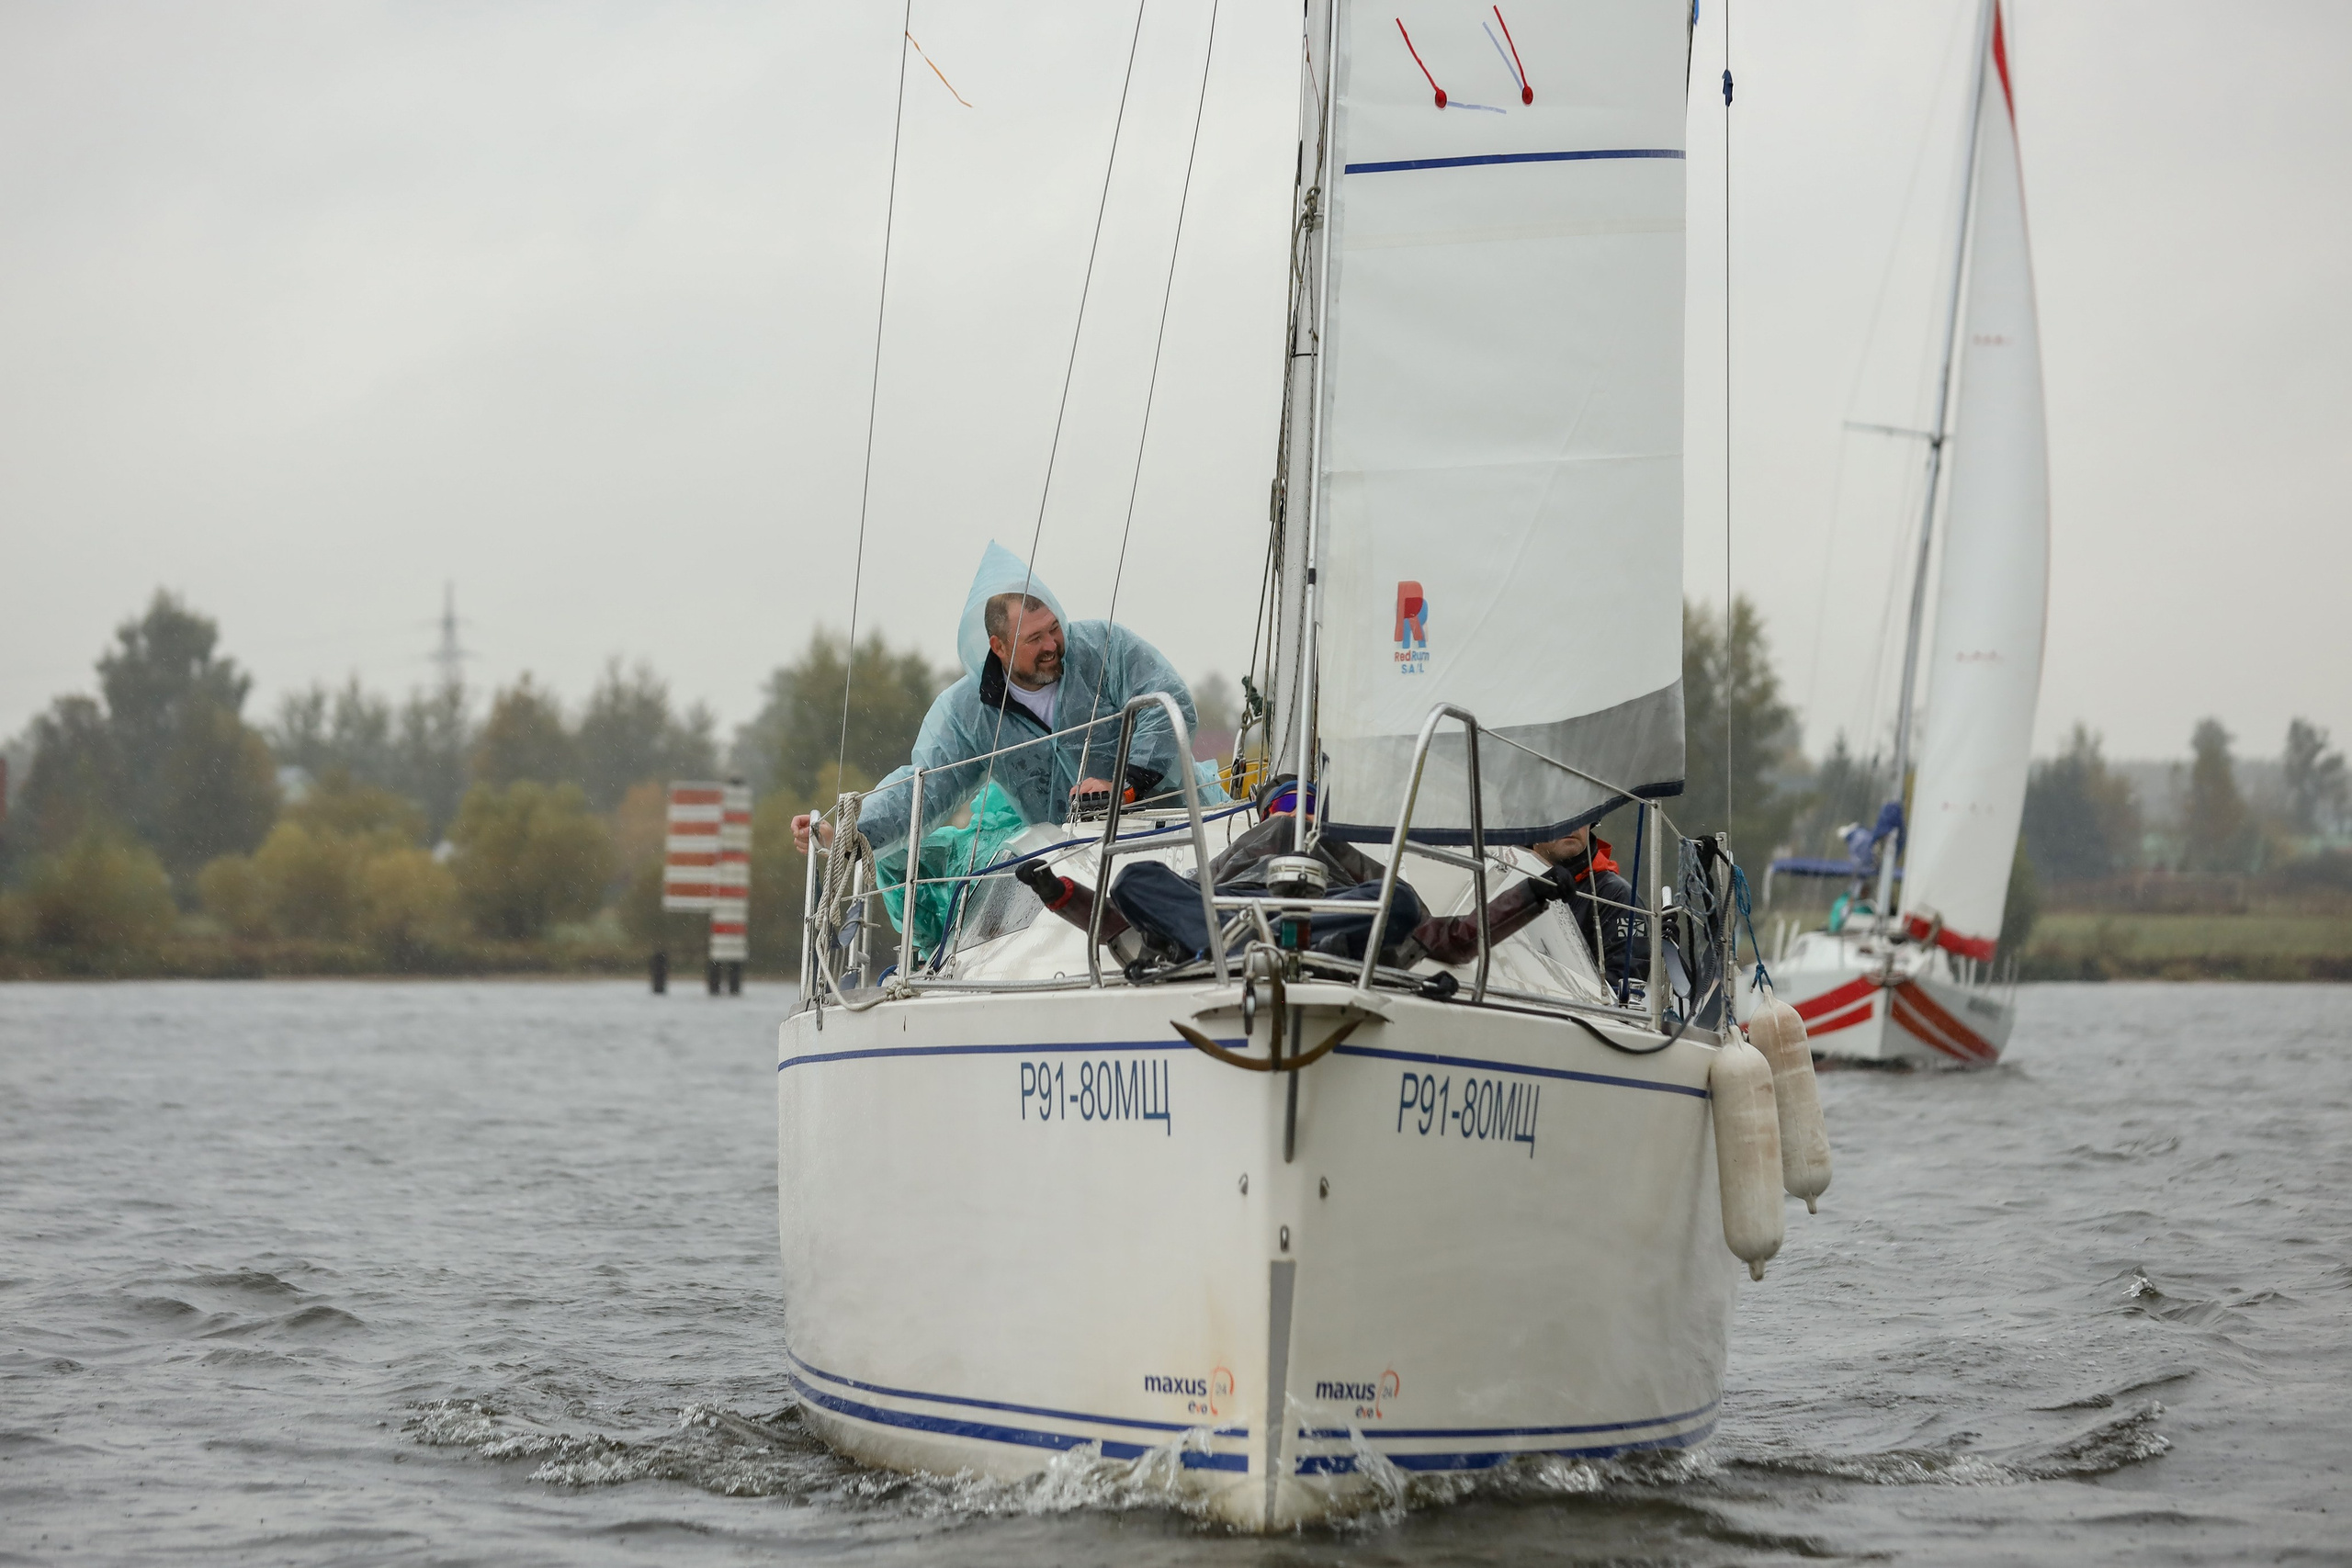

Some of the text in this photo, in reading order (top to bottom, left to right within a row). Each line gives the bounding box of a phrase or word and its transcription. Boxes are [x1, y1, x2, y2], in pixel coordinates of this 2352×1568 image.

[1021, 1059, 1170, 1136] Р91-80МЩ
[1397, 1072, 1540, 1159] Р91-80МЩ
[1145, 1374, 1207, 1396] maxus
[1316, 1381, 1376, 1401] maxus
[1188, 1400, 1207, 1414] evo
